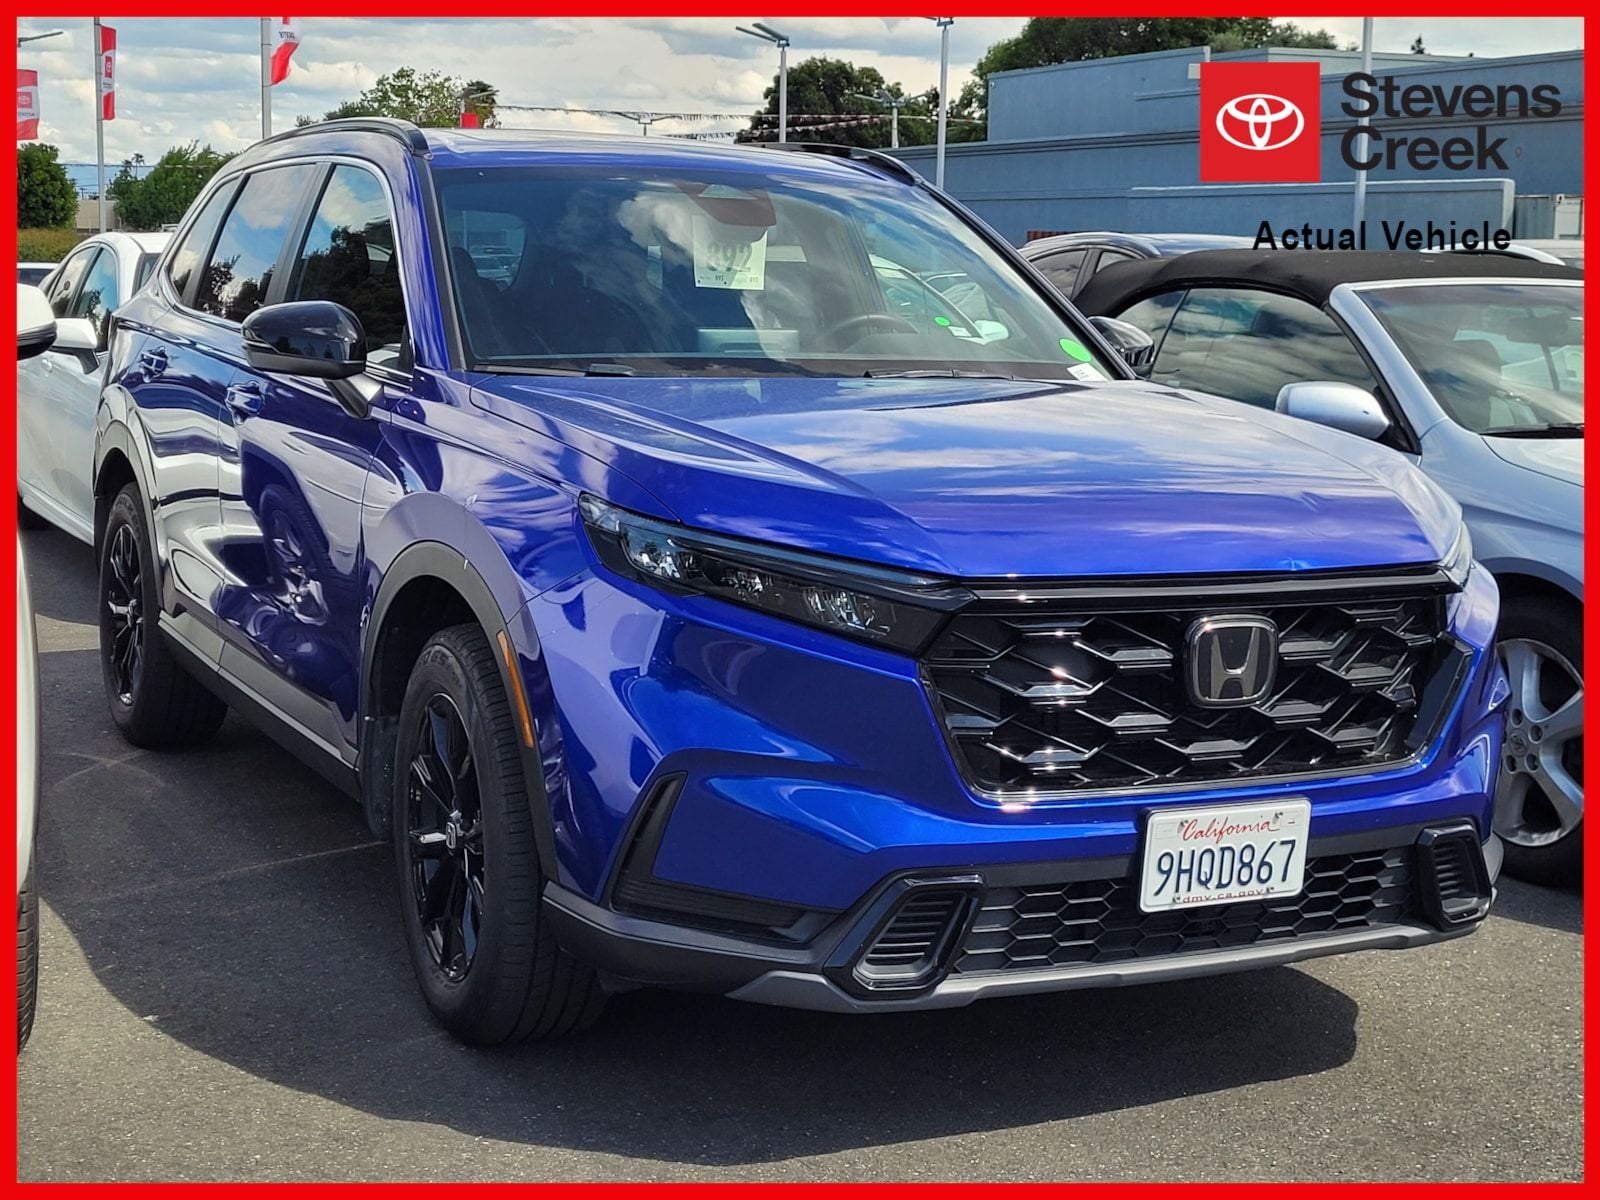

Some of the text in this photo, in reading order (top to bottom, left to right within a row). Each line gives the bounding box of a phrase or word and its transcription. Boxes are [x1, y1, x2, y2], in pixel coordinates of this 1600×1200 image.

[707, 241, 752, 273] 892
[1182, 816, 1280, 844] California
[1153, 839, 1296, 896] 9HQD867
[1183, 888, 1265, 904] dmv.ca.gov
